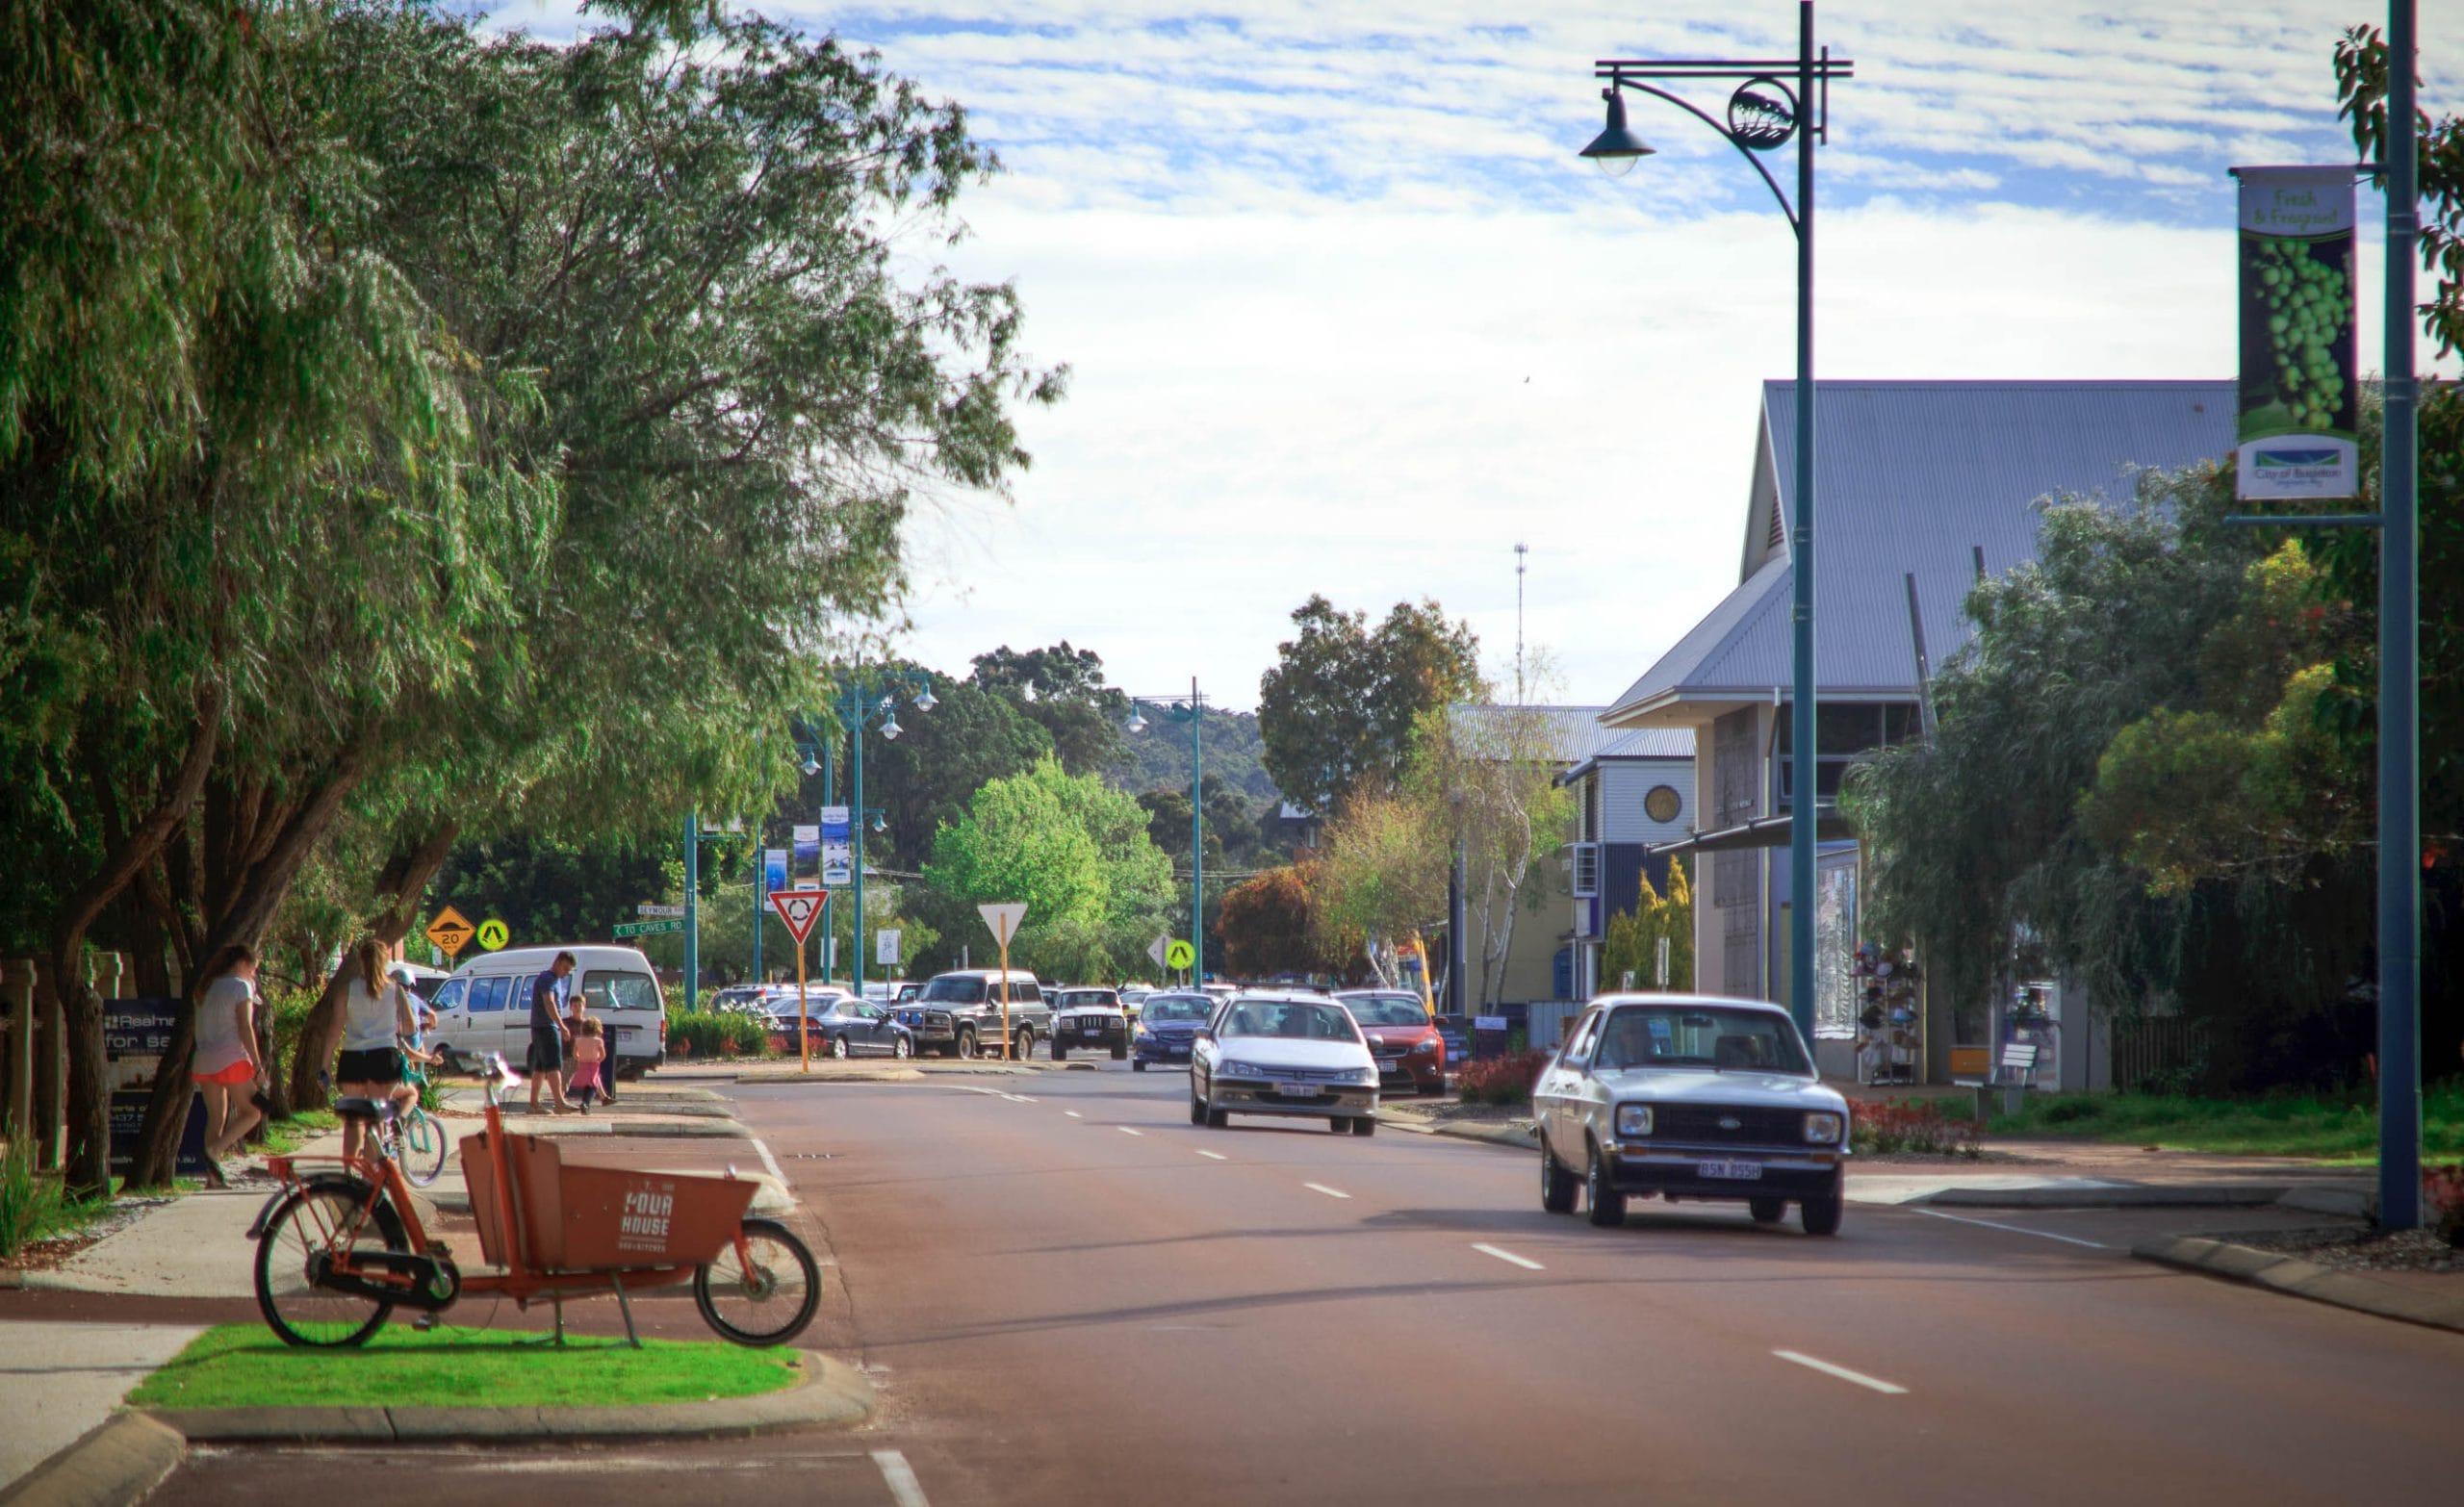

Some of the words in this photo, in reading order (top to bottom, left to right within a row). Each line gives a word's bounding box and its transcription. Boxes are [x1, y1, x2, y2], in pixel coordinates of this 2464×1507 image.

[639, 906, 673, 915] SEYMOUR
[626, 926, 635, 934] TO
[639, 923, 667, 932] CAVES
[670, 921, 682, 931] RD
[442, 933, 459, 944] 20
[105, 1034, 139, 1048] for
[625, 1192, 673, 1216] POUR
[621, 1216, 670, 1236] HOUSE
